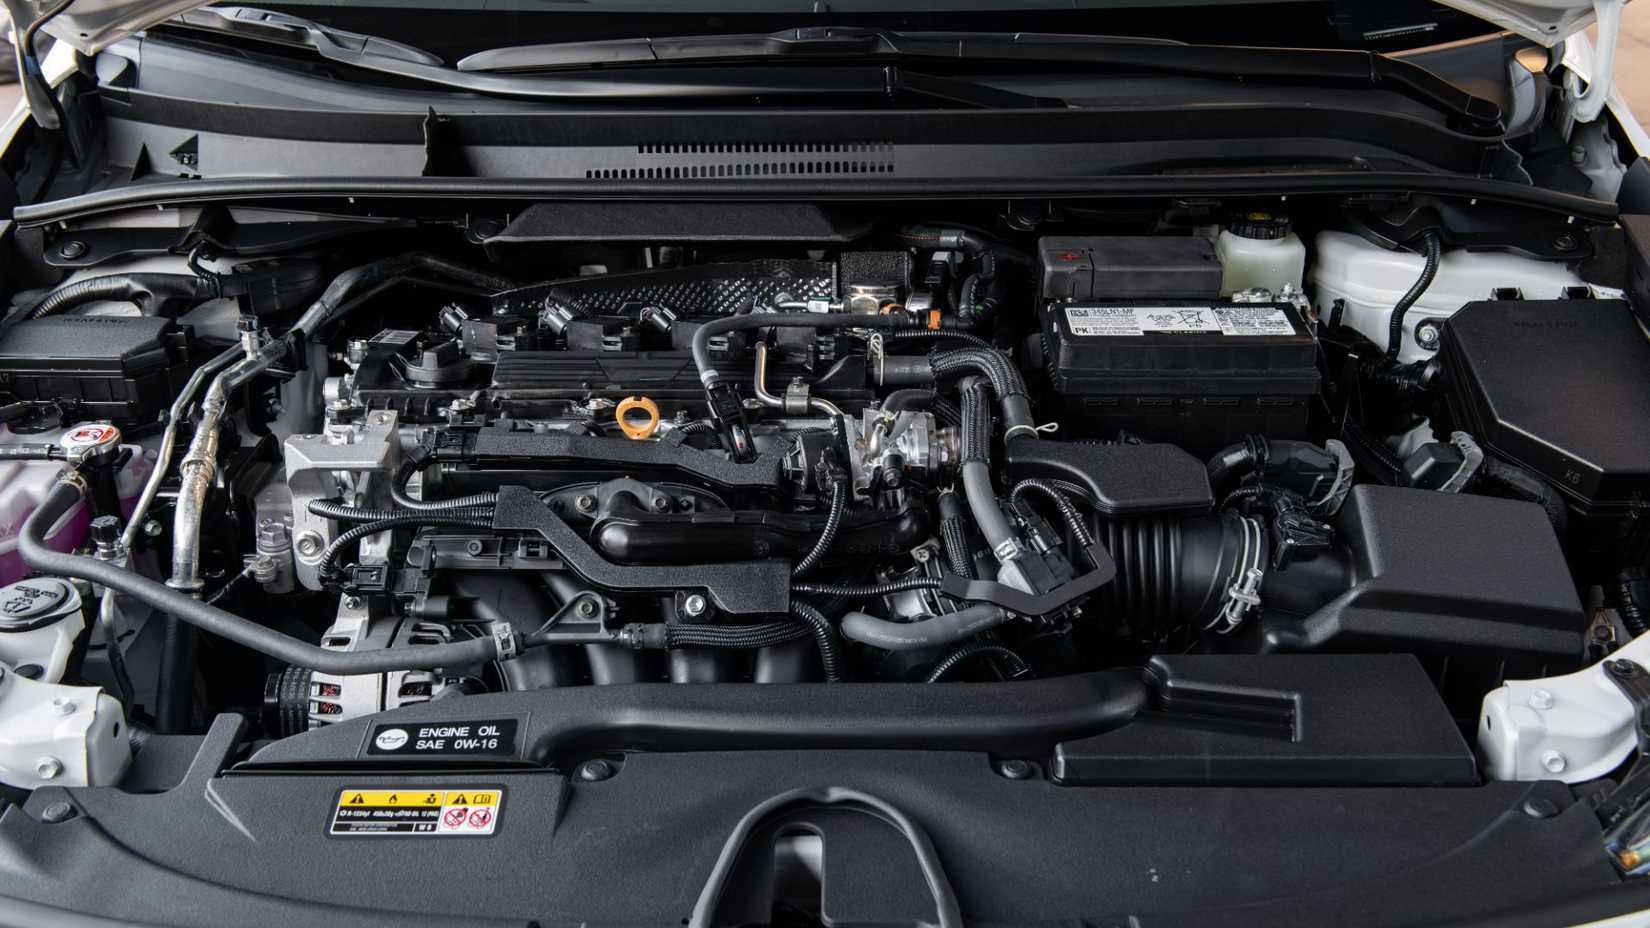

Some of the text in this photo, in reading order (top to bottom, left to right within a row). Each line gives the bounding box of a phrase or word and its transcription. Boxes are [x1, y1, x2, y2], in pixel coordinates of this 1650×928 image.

[419, 725, 500, 738] ENGINE OIL
[415, 738, 498, 750] SAE 0W-16
